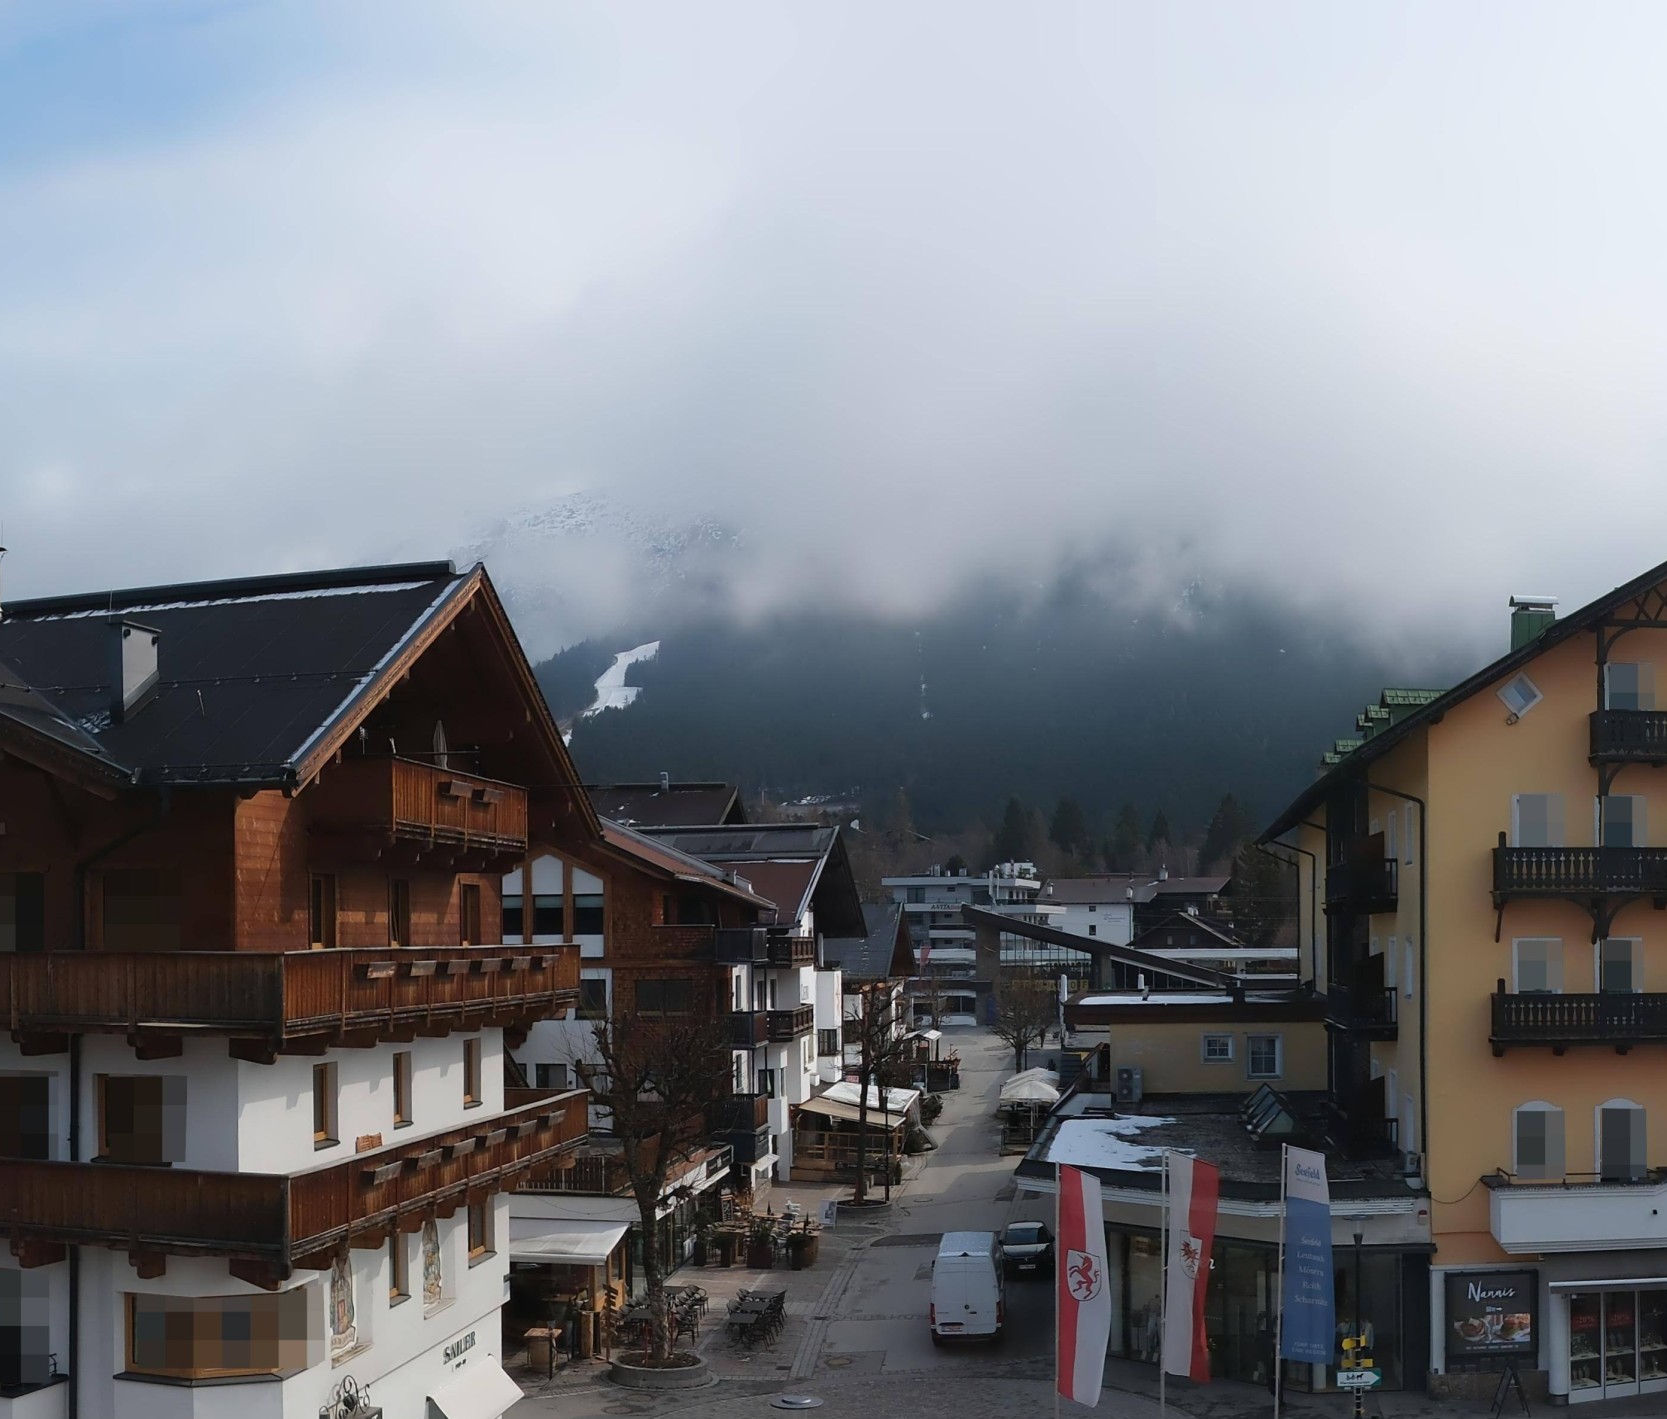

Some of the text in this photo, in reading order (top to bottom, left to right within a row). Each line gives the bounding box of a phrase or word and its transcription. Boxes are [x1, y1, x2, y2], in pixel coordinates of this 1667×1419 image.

[1294, 1163, 1321, 1180] Seefeld
[1468, 1280, 1516, 1302] Nannis
[443, 1331, 476, 1365] SAILER
